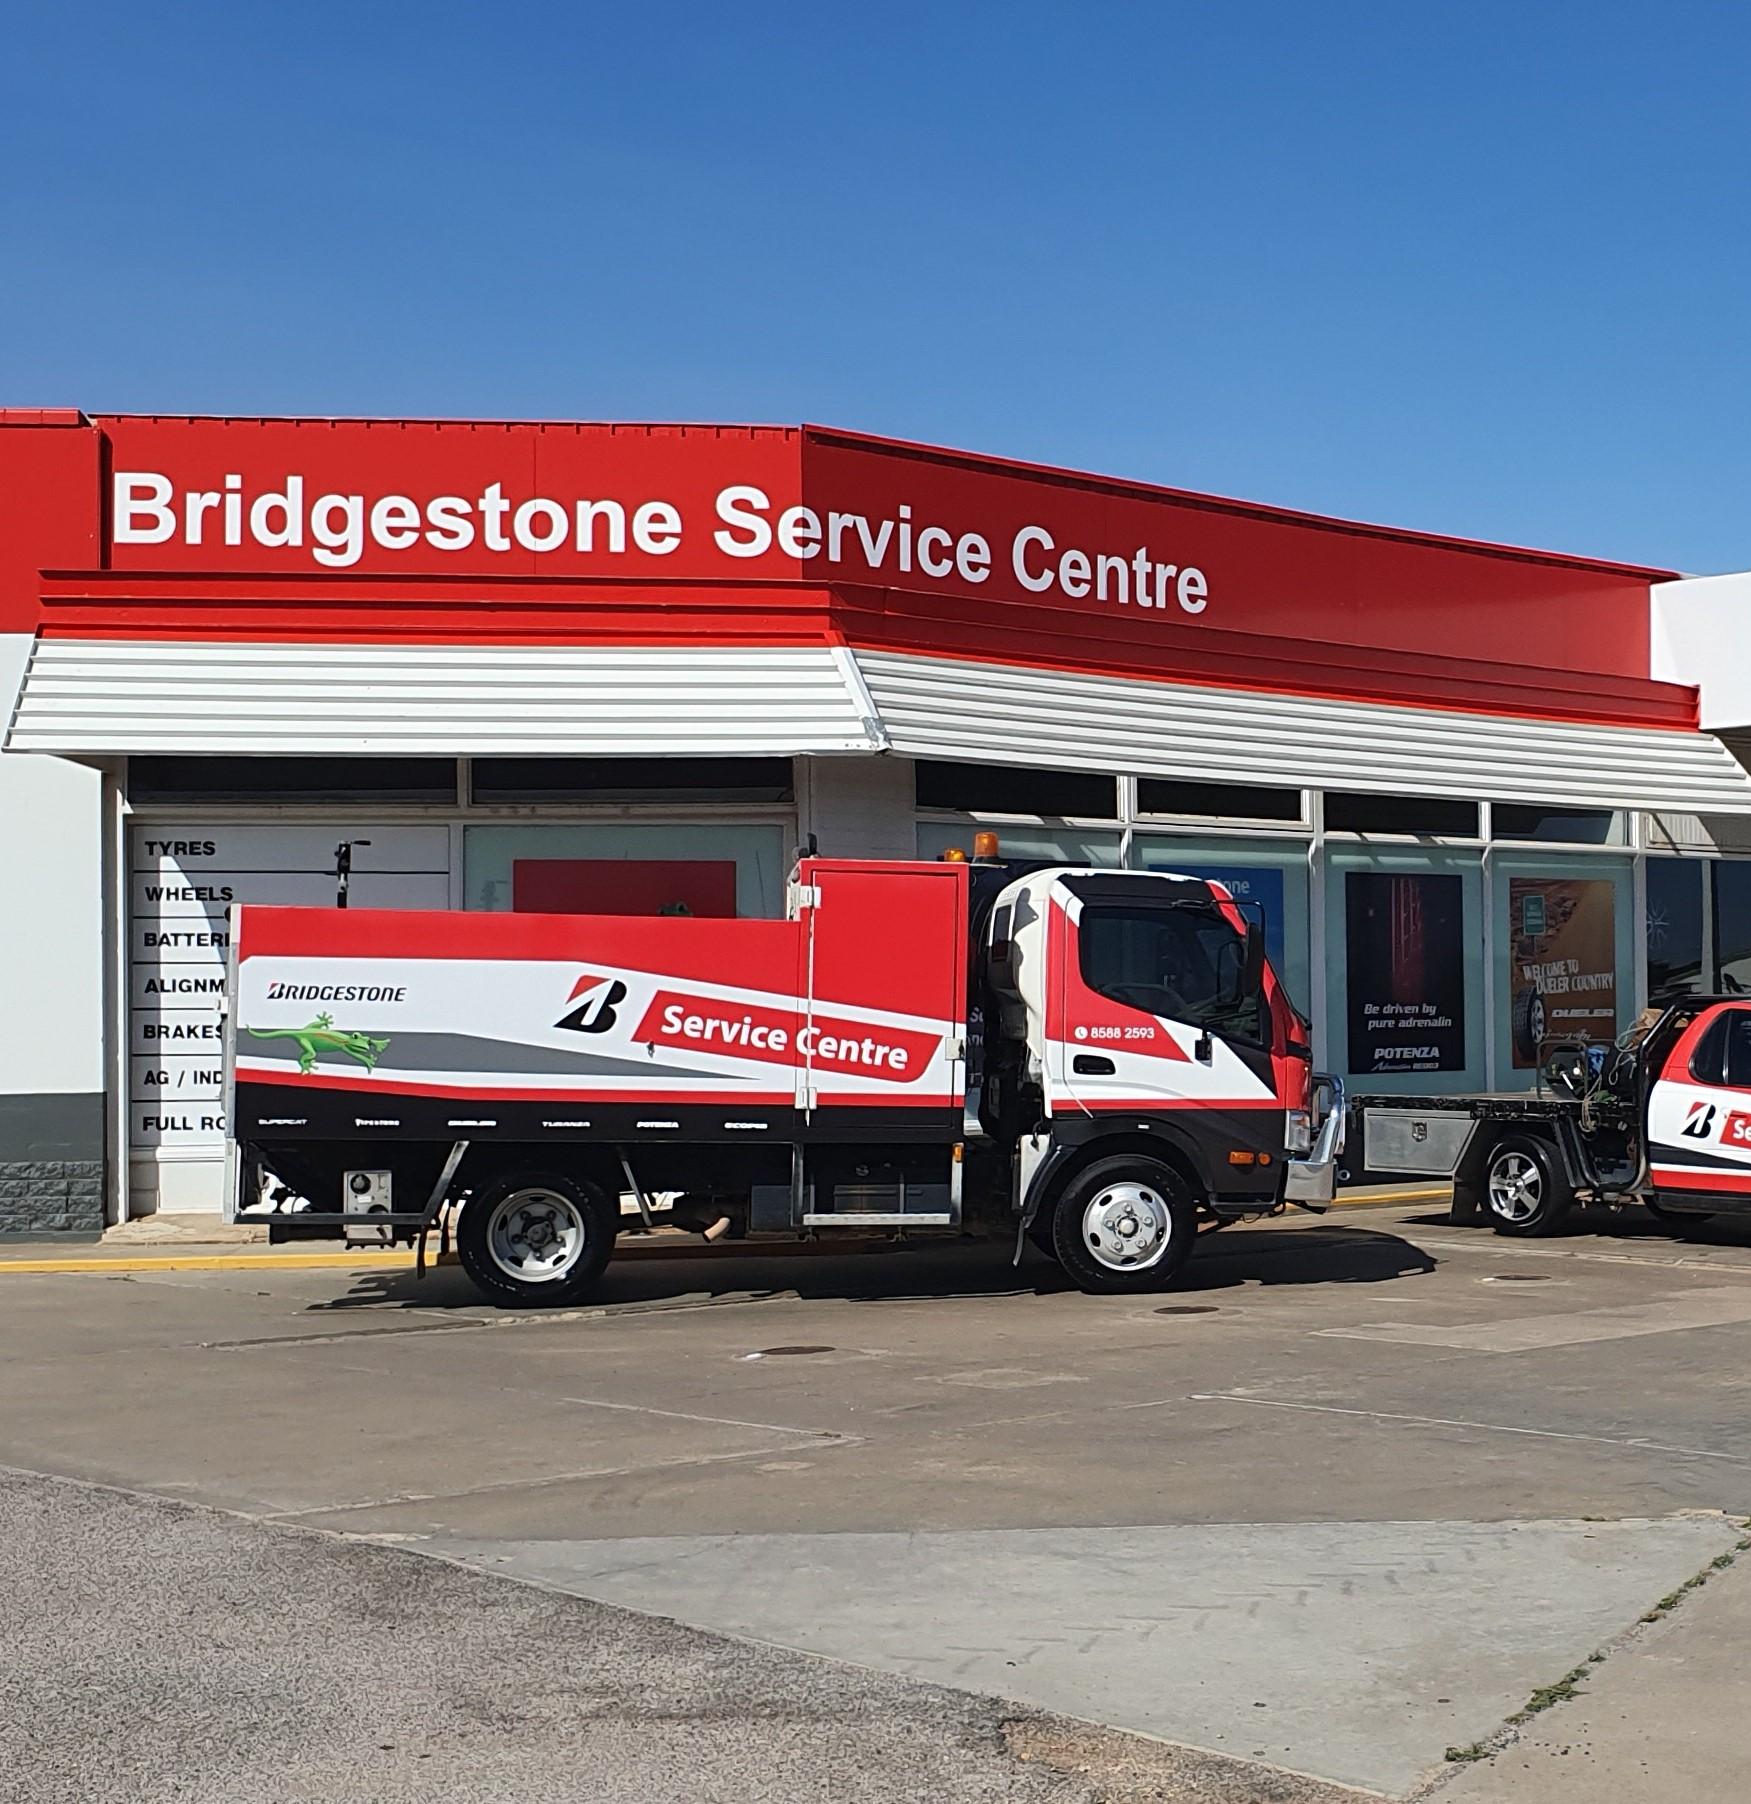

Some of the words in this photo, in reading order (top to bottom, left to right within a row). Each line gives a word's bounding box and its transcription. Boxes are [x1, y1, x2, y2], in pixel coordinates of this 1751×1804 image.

[113, 471, 683, 568] Bridgestone
[713, 484, 992, 583] Service
[1012, 525, 1209, 614] Centre
[144, 841, 216, 857] TYRES
[145, 886, 234, 902] WHEELS
[144, 932, 230, 948] BATTERI
[1523, 961, 1566, 980] WELCOME
[145, 978, 226, 994] ALIGNM
[1571, 973, 1614, 992] COUNTRY
[267, 982, 407, 1002] BRIDGESTONE
[1364, 1003, 1379, 1014] Be
[1383, 1003, 1419, 1014] driven
[1422, 1003, 1437, 1015] by
[1368, 1018, 1395, 1031] pure
[1398, 1016, 1452, 1028] adrenalin
[660, 1005, 787, 1051] Service
[795, 1027, 909, 1071] Centre
[1091, 1027, 1121, 1039] 8588
[1125, 1027, 1155, 1039] 2593
[1374, 1046, 1440, 1059] POTENZA
[144, 1070, 169, 1086] AG
[143, 1116, 193, 1132] FULL
